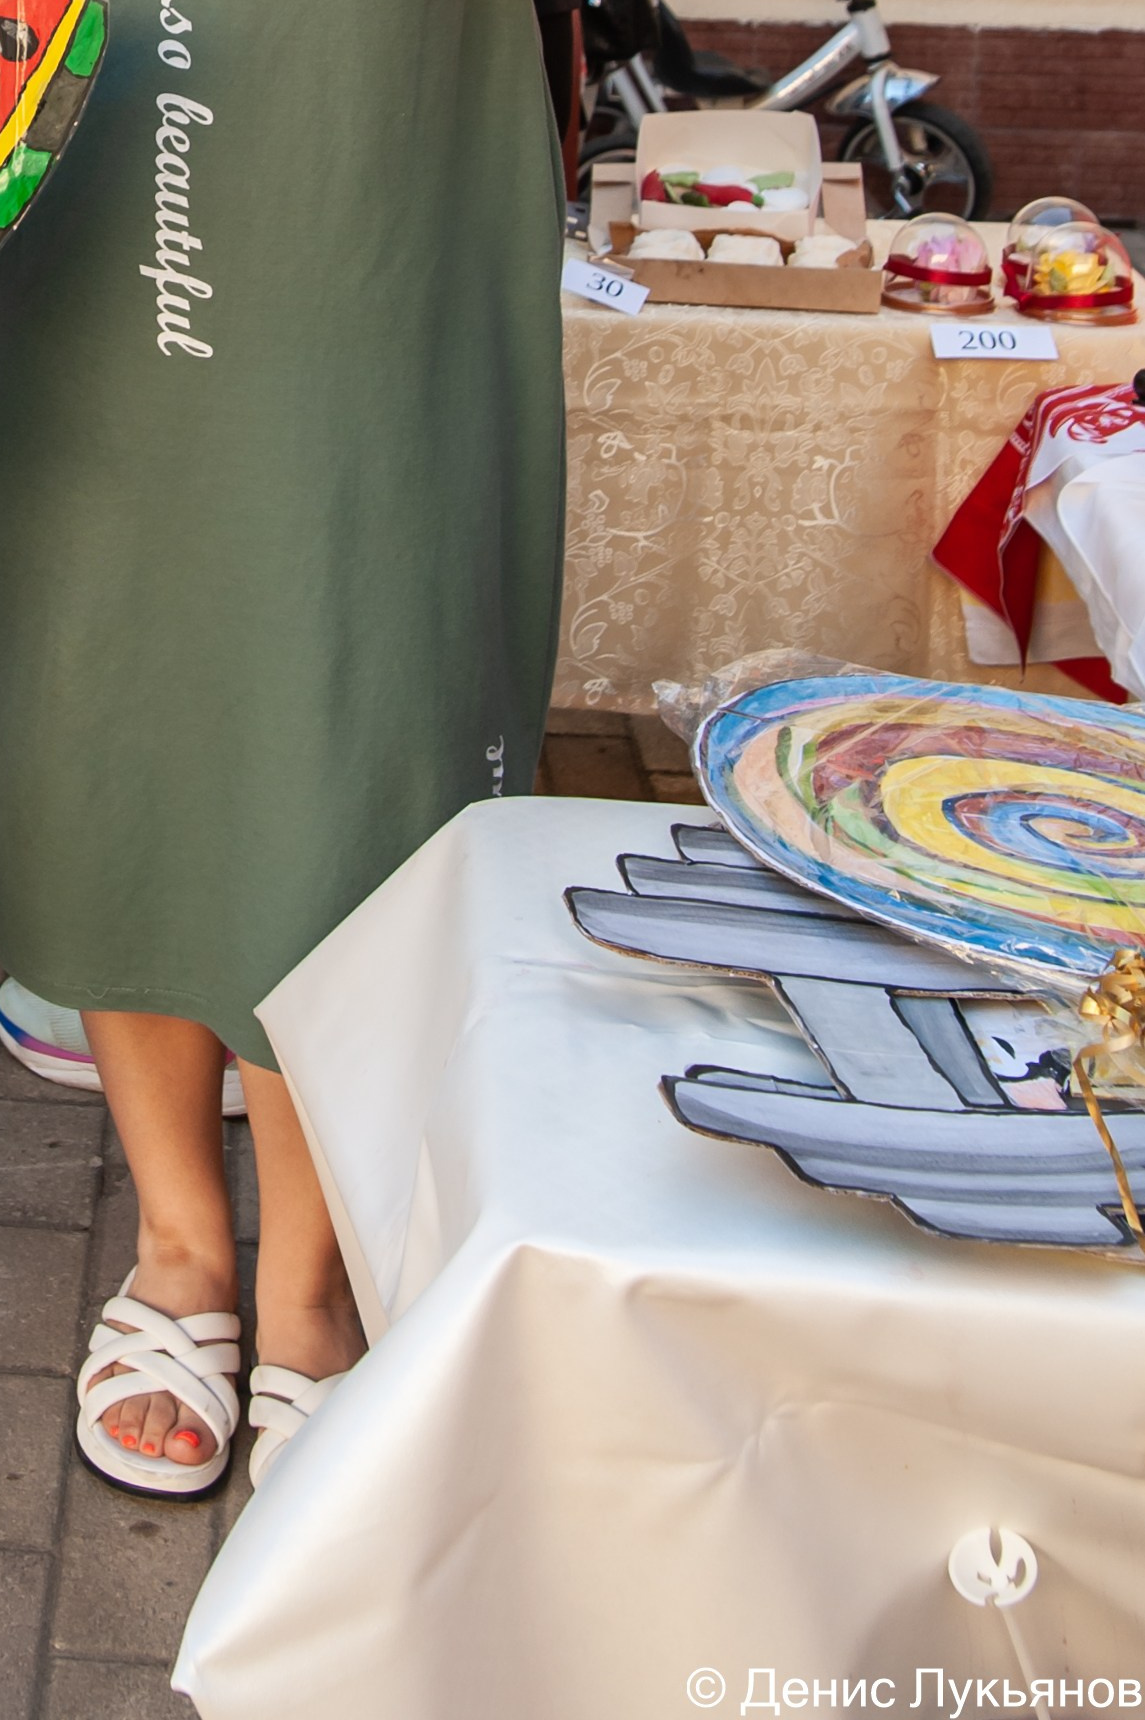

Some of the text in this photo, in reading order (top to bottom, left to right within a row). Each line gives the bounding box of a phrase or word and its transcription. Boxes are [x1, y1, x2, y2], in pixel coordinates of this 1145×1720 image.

[139, 91, 213, 358] beautiful
[586, 272, 624, 298] 30
[958, 329, 1017, 351] 200
